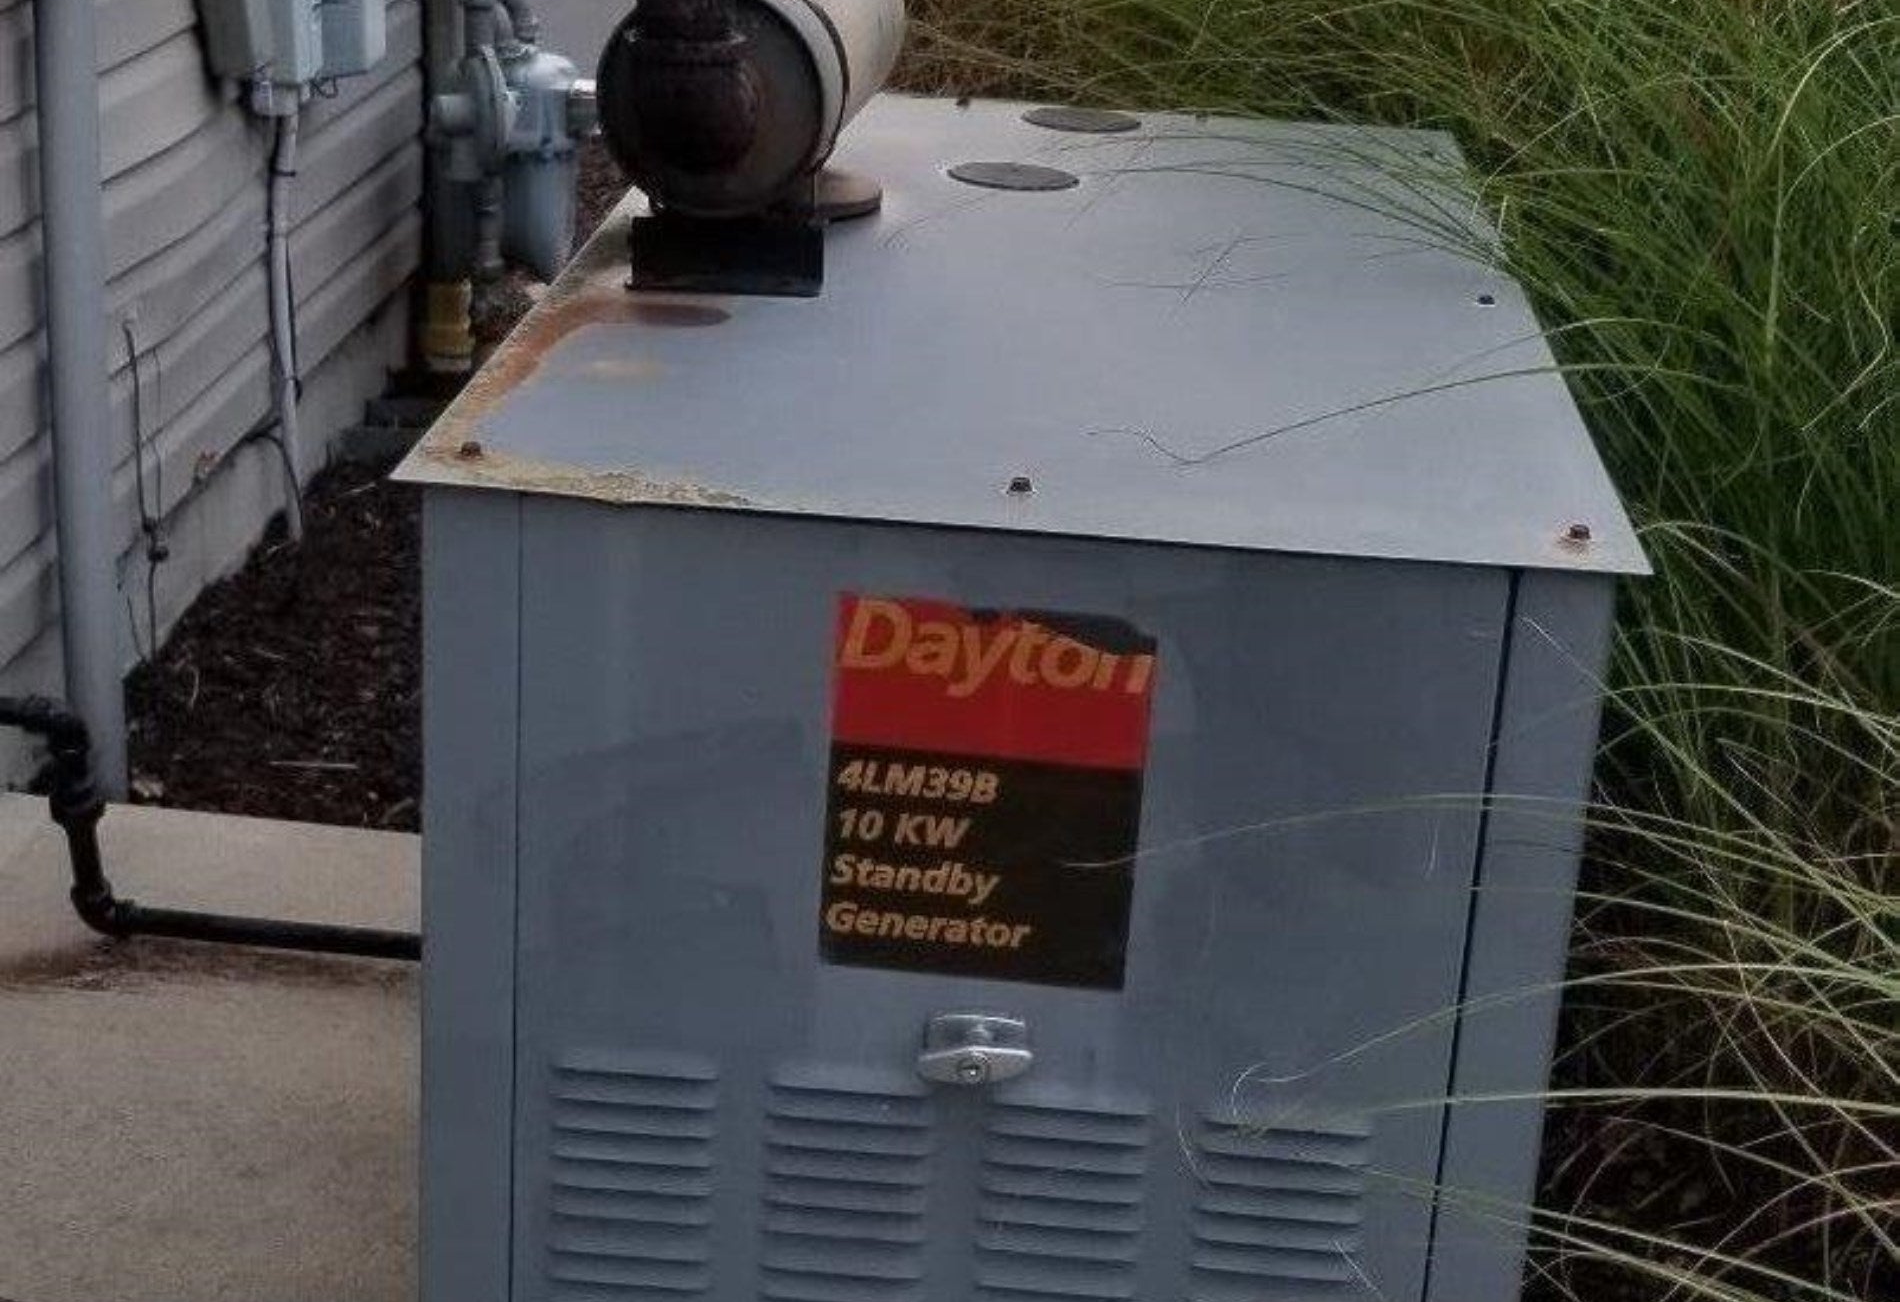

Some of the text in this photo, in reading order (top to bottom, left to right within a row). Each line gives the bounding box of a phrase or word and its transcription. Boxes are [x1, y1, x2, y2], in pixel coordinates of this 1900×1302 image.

[841, 598, 1156, 697] Dayton
[837, 760, 999, 804] 4LM39B
[840, 808, 972, 848] 10 KW
[831, 852, 1000, 905] Standby
[826, 901, 1032, 948] Generator
